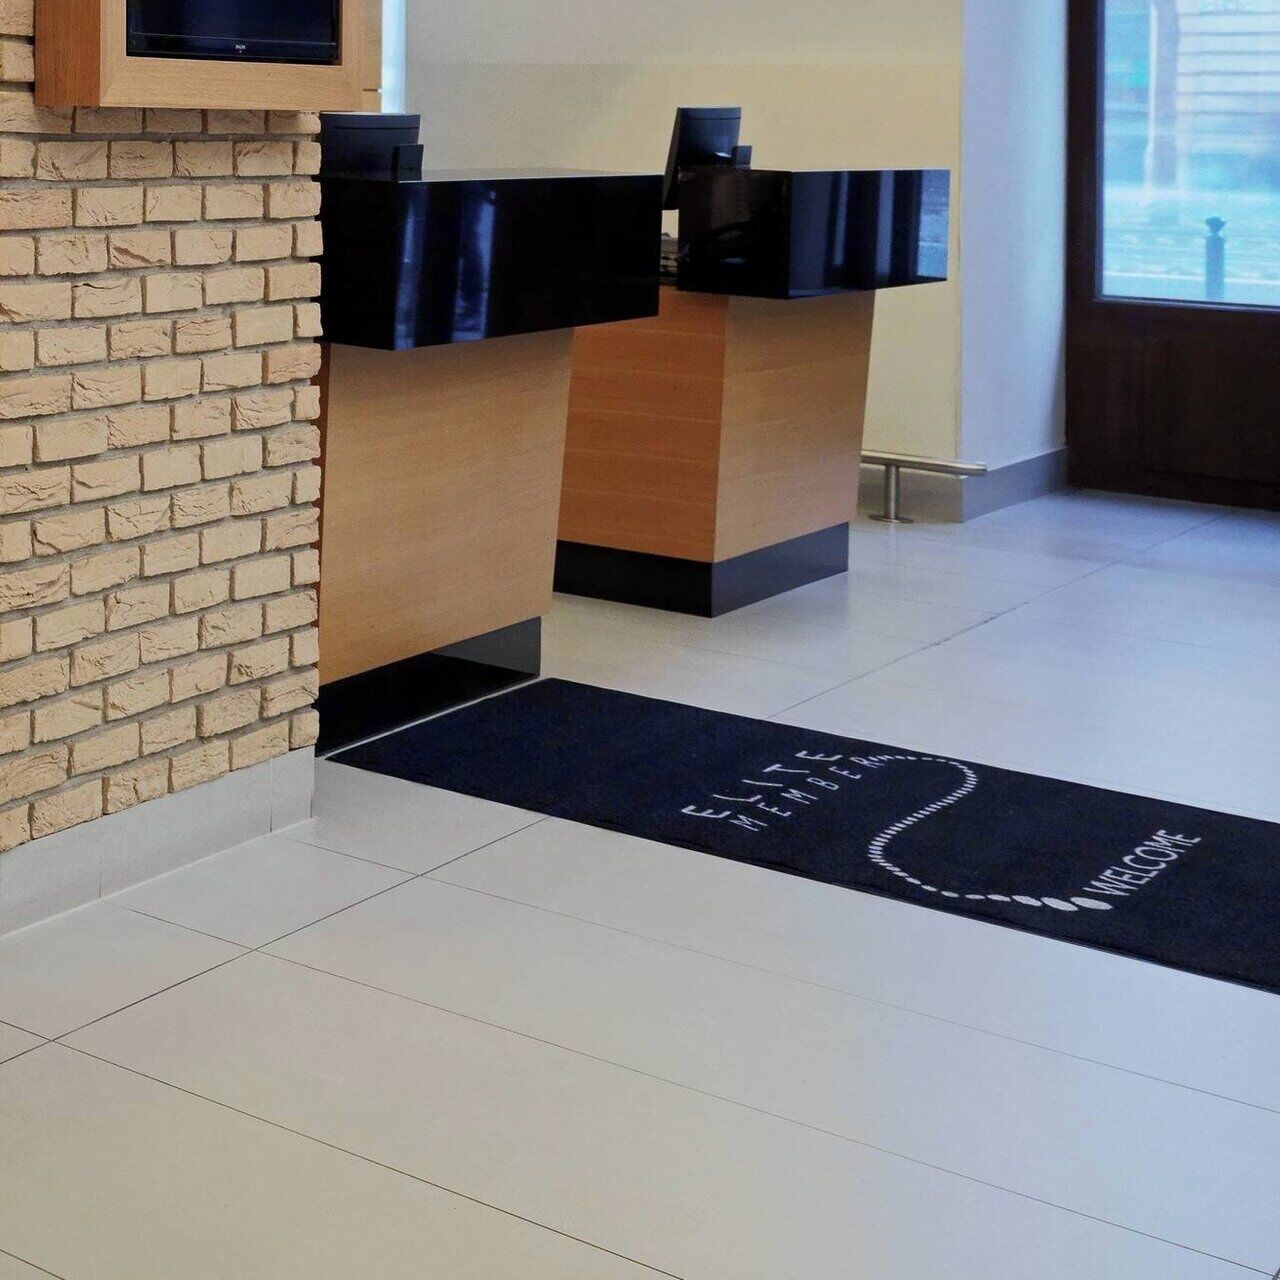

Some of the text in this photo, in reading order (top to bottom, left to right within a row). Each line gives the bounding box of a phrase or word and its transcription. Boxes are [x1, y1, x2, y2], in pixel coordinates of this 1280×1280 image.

[681, 750, 843, 819] ELITE
[728, 756, 880, 832] MEMBER
[1081, 829, 1203, 897] WELCOME
